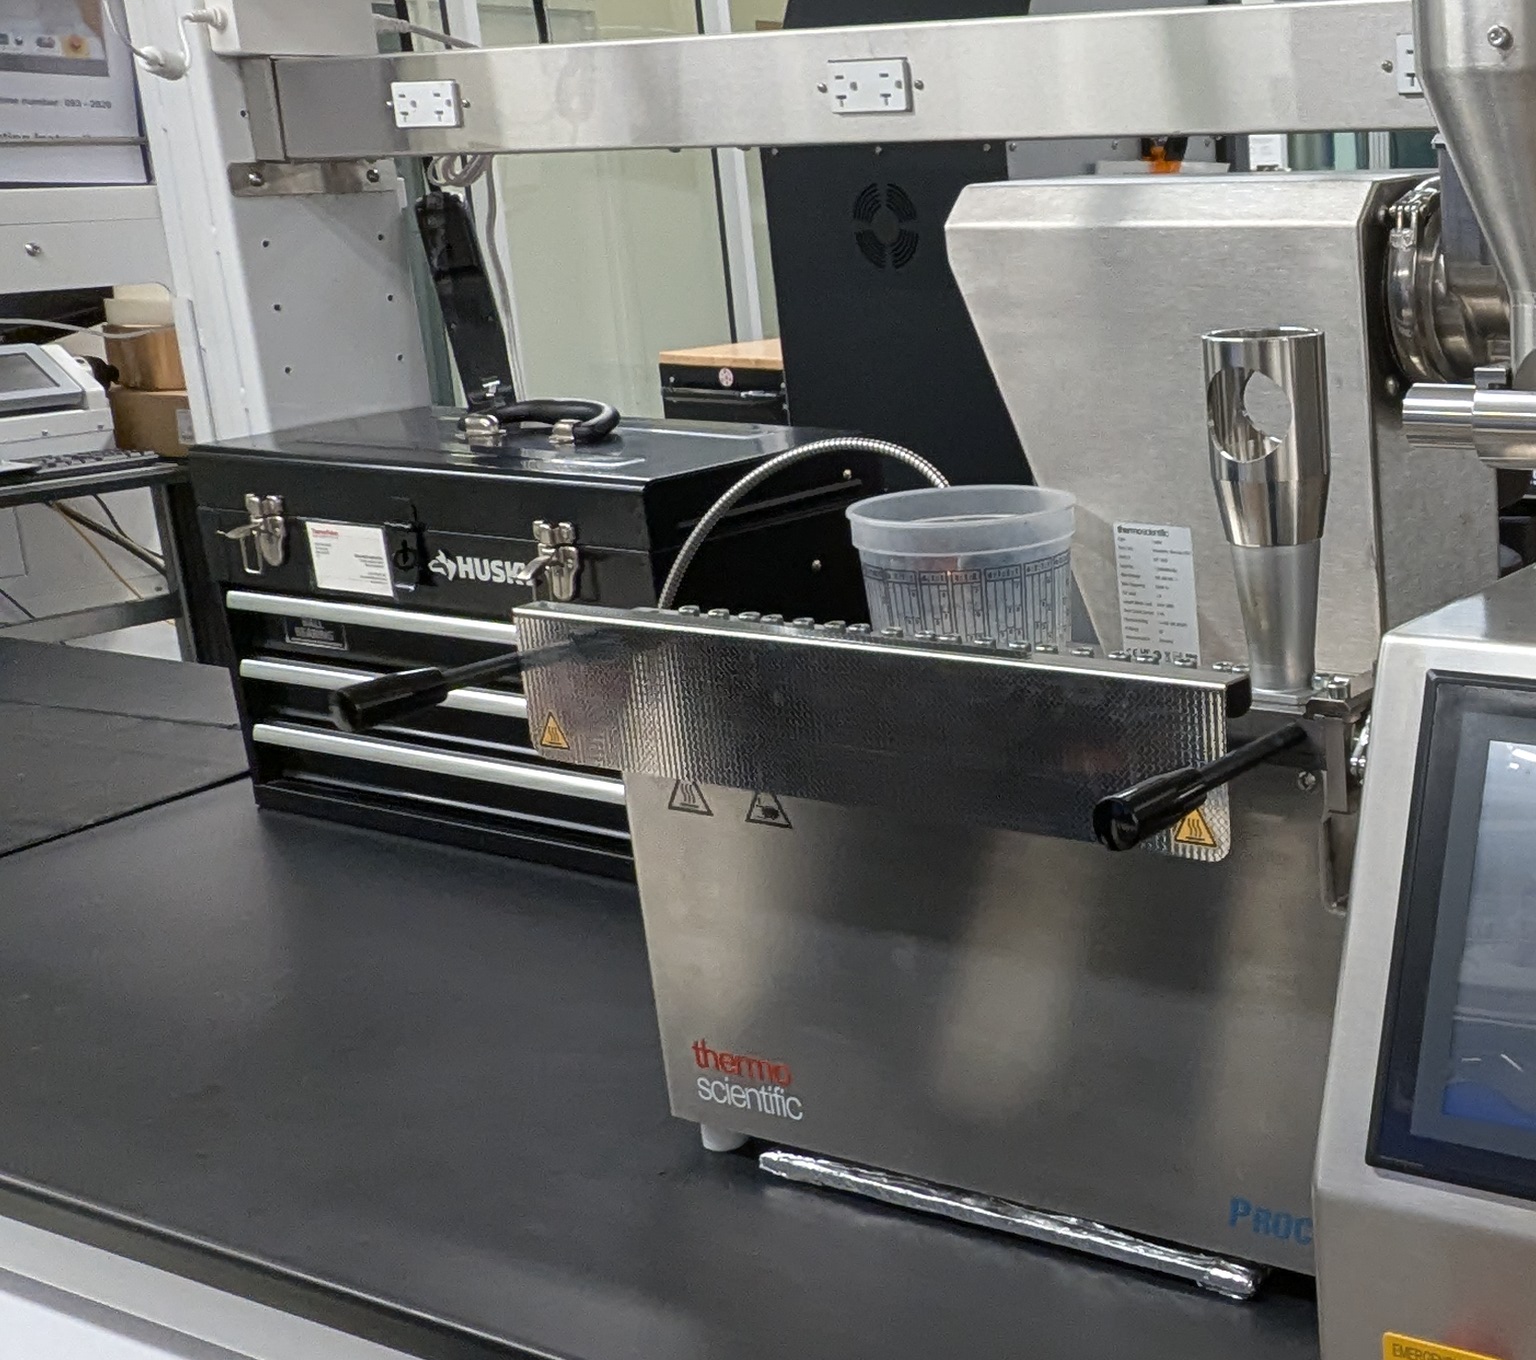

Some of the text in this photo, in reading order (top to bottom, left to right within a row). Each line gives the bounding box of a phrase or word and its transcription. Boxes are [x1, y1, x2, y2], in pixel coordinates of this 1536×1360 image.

[456, 555, 535, 586] HUSK
[692, 1038, 793, 1088] thermo
[697, 1077, 803, 1120] scientific
